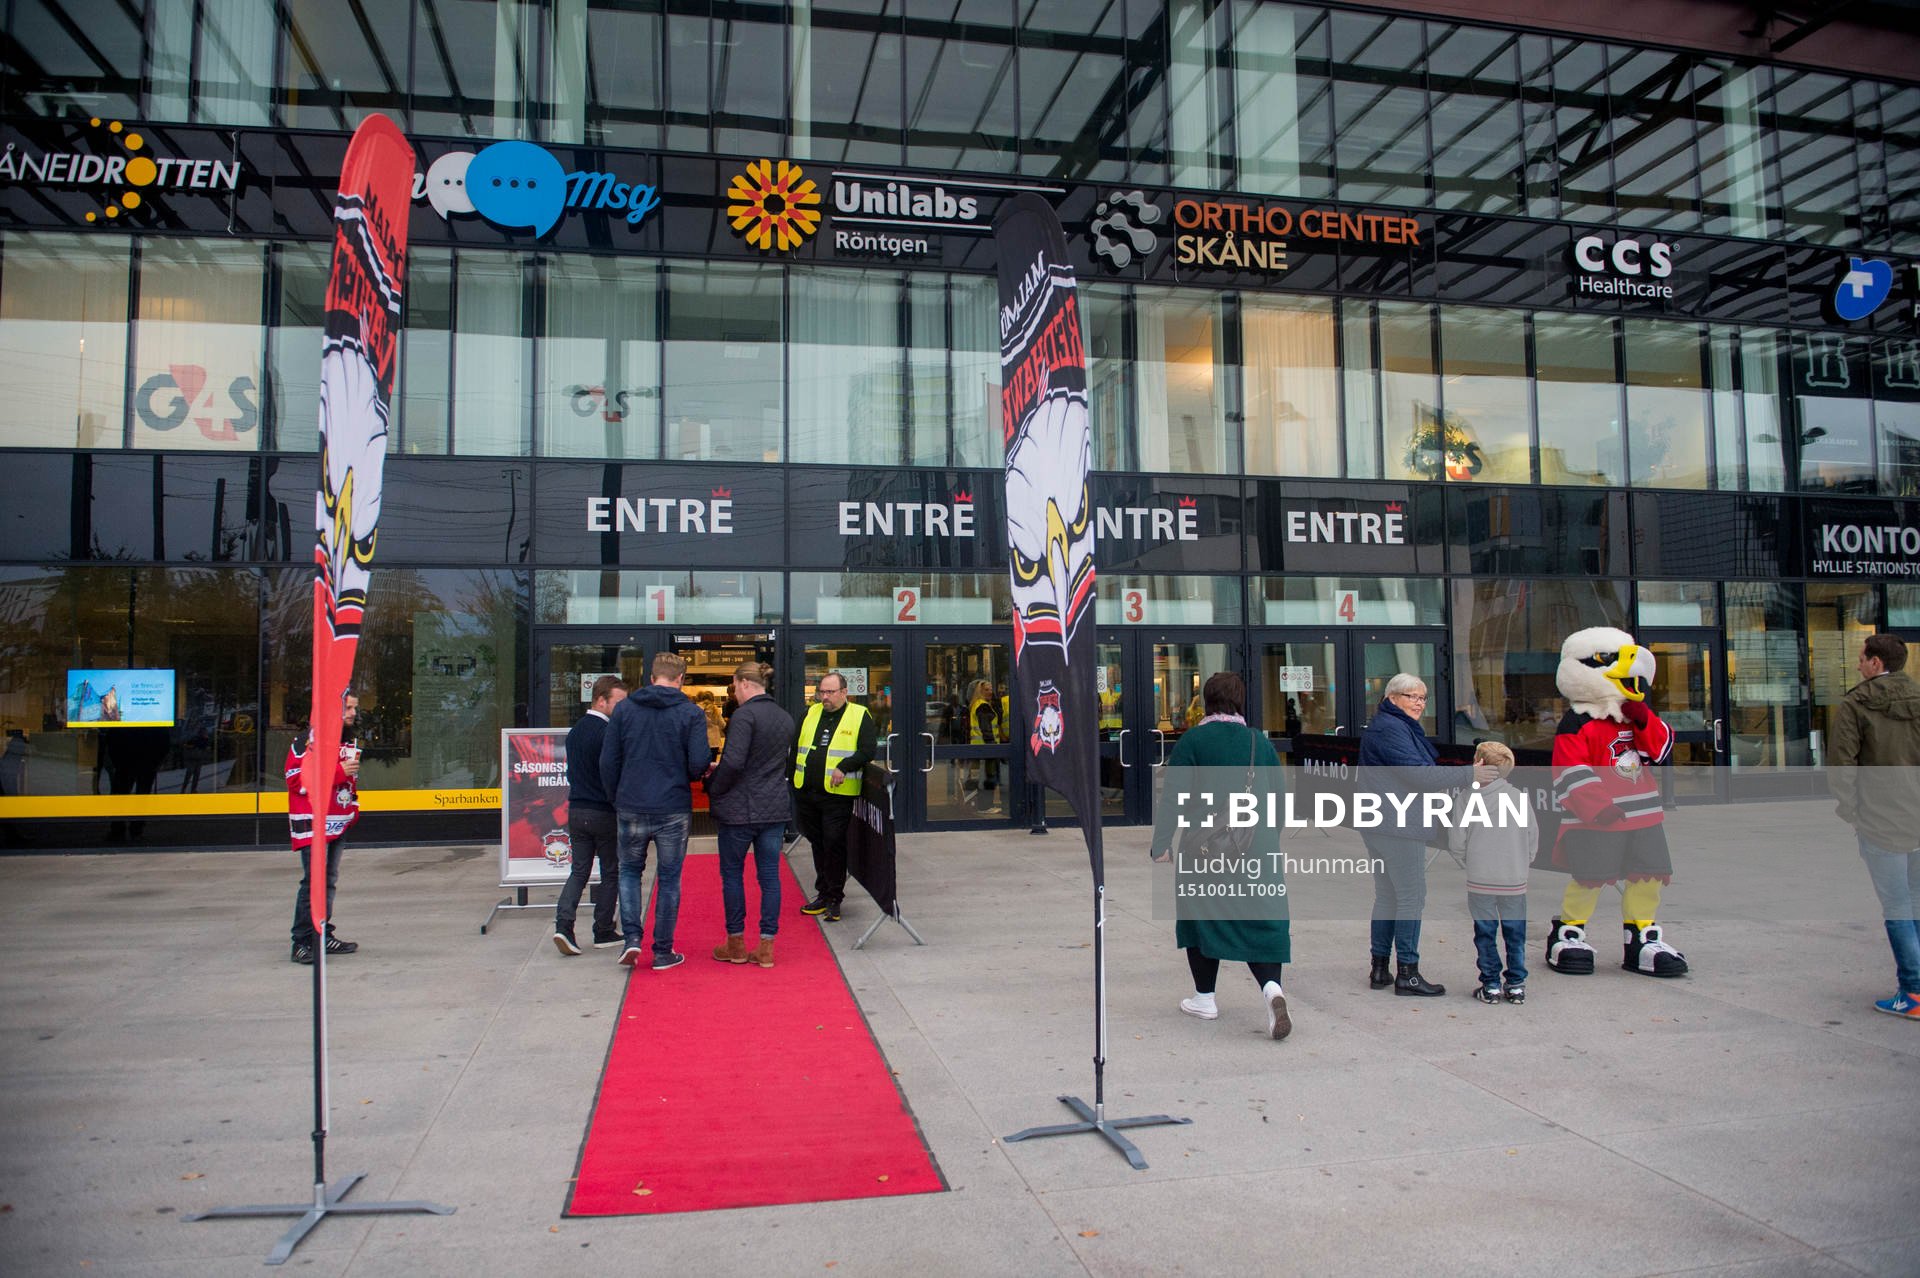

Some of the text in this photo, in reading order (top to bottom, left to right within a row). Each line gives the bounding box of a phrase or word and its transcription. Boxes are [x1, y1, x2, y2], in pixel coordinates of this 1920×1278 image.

[565, 170, 661, 224] Msg
[835, 181, 978, 220] Unilabs
[1174, 200, 1420, 246] ORTHO CENTER
[835, 231, 928, 256] Röntgen
[1177, 231, 1288, 270] SKÅNE
[1580, 275, 1673, 299] Healthcare
[136, 364, 258, 441] G4S
[1822, 524, 1920, 555] KONTO
[1813, 559, 1853, 573] HYLLIE
[650, 589, 666, 621] 1
[897, 590, 917, 622] 2
[1125, 591, 1144, 623] 3
[1338, 593, 1356, 623] 4
[434, 793, 499, 807] Sparbanken
